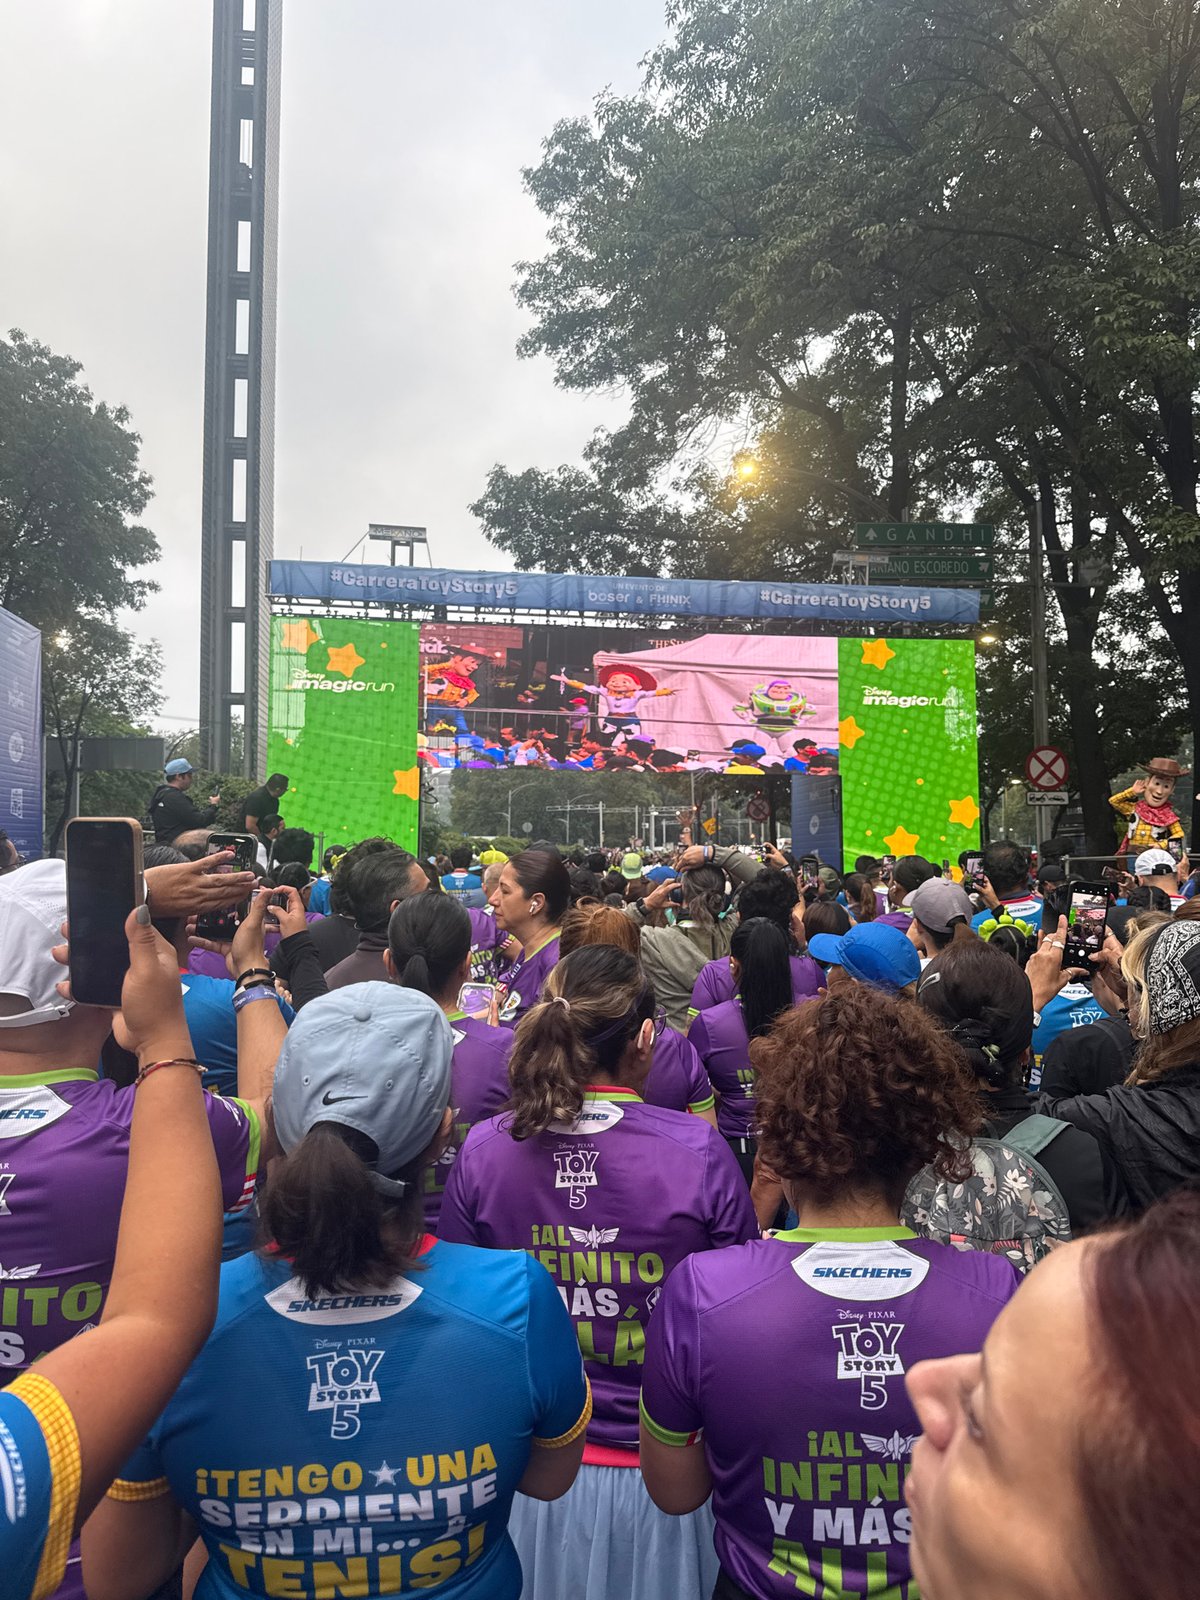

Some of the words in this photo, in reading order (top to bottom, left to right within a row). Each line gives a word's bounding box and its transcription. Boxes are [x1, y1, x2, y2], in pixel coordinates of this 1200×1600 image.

[886, 528, 985, 541] GANDHI
[914, 560, 969, 574] ESCOBEDO
[330, 569, 518, 599] #CarreraToyStory5
[649, 593, 691, 605] FHINIX
[760, 590, 931, 613] #CarreraToyStory5
[553, 1150, 600, 1175] TOY
[559, 1175, 594, 1184] STORY
[568, 1184, 588, 1210] 5
[531, 1224, 571, 1247] ¡AL
[812, 1267, 913, 1279] SKECHERS
[286, 1294, 403, 1313] SKECHERS
[556, 1277, 620, 1317] ÁS
[836, 1308, 864, 1322] Disney
[868, 1311, 896, 1319] PIXAR
[313, 1339, 342, 1350] Disney
[347, 1338, 377, 1346] PIXAR
[832, 1322, 905, 1359] TOY
[306, 1348, 385, 1391] TOY
[844, 1360, 897, 1372] STORY
[316, 1387, 374, 1403] STORY
[860, 1372, 888, 1411] 5
[330, 1402, 361, 1440] 5
[807, 1430, 863, 1459] ¡AL
[196, 1461, 363, 1498] ¡TENGO
[407, 1443, 498, 1487] UNA
[762, 1457, 913, 1502] INFIN
[764, 1497, 795, 1536] Y
[235, 1529, 294, 1555] EN
